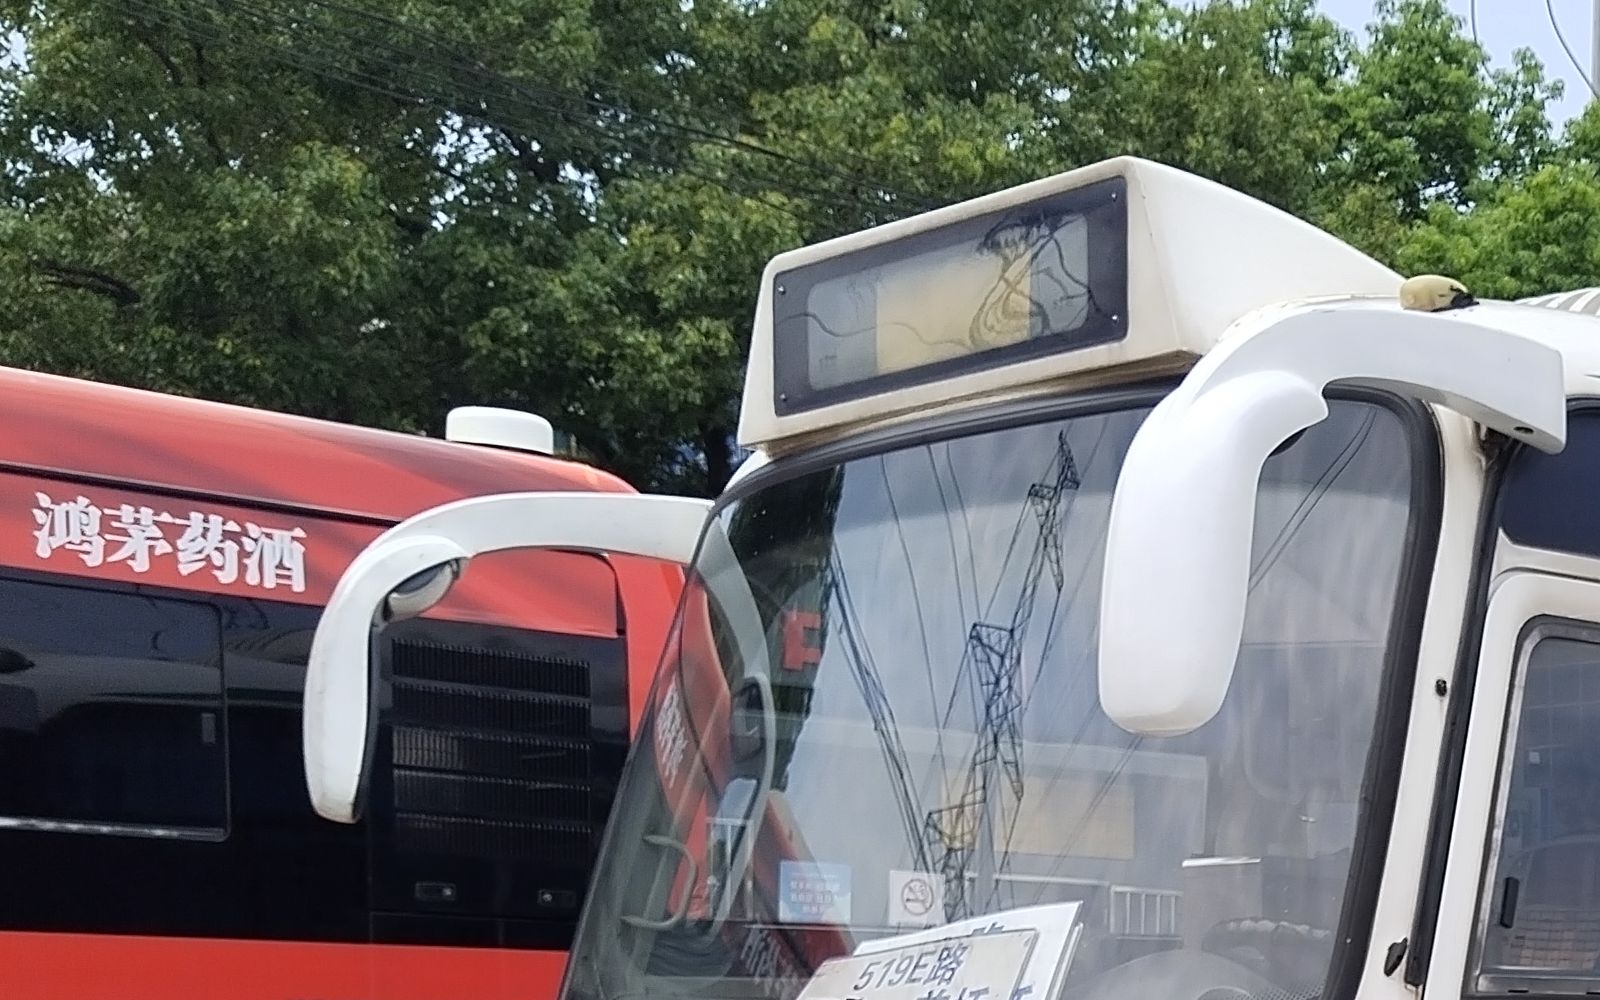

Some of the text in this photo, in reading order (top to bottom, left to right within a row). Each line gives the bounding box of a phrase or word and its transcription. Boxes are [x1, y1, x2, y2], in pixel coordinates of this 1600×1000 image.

[32, 491, 308, 594] 鸿茅药酒
[853, 942, 971, 992] 519E路
